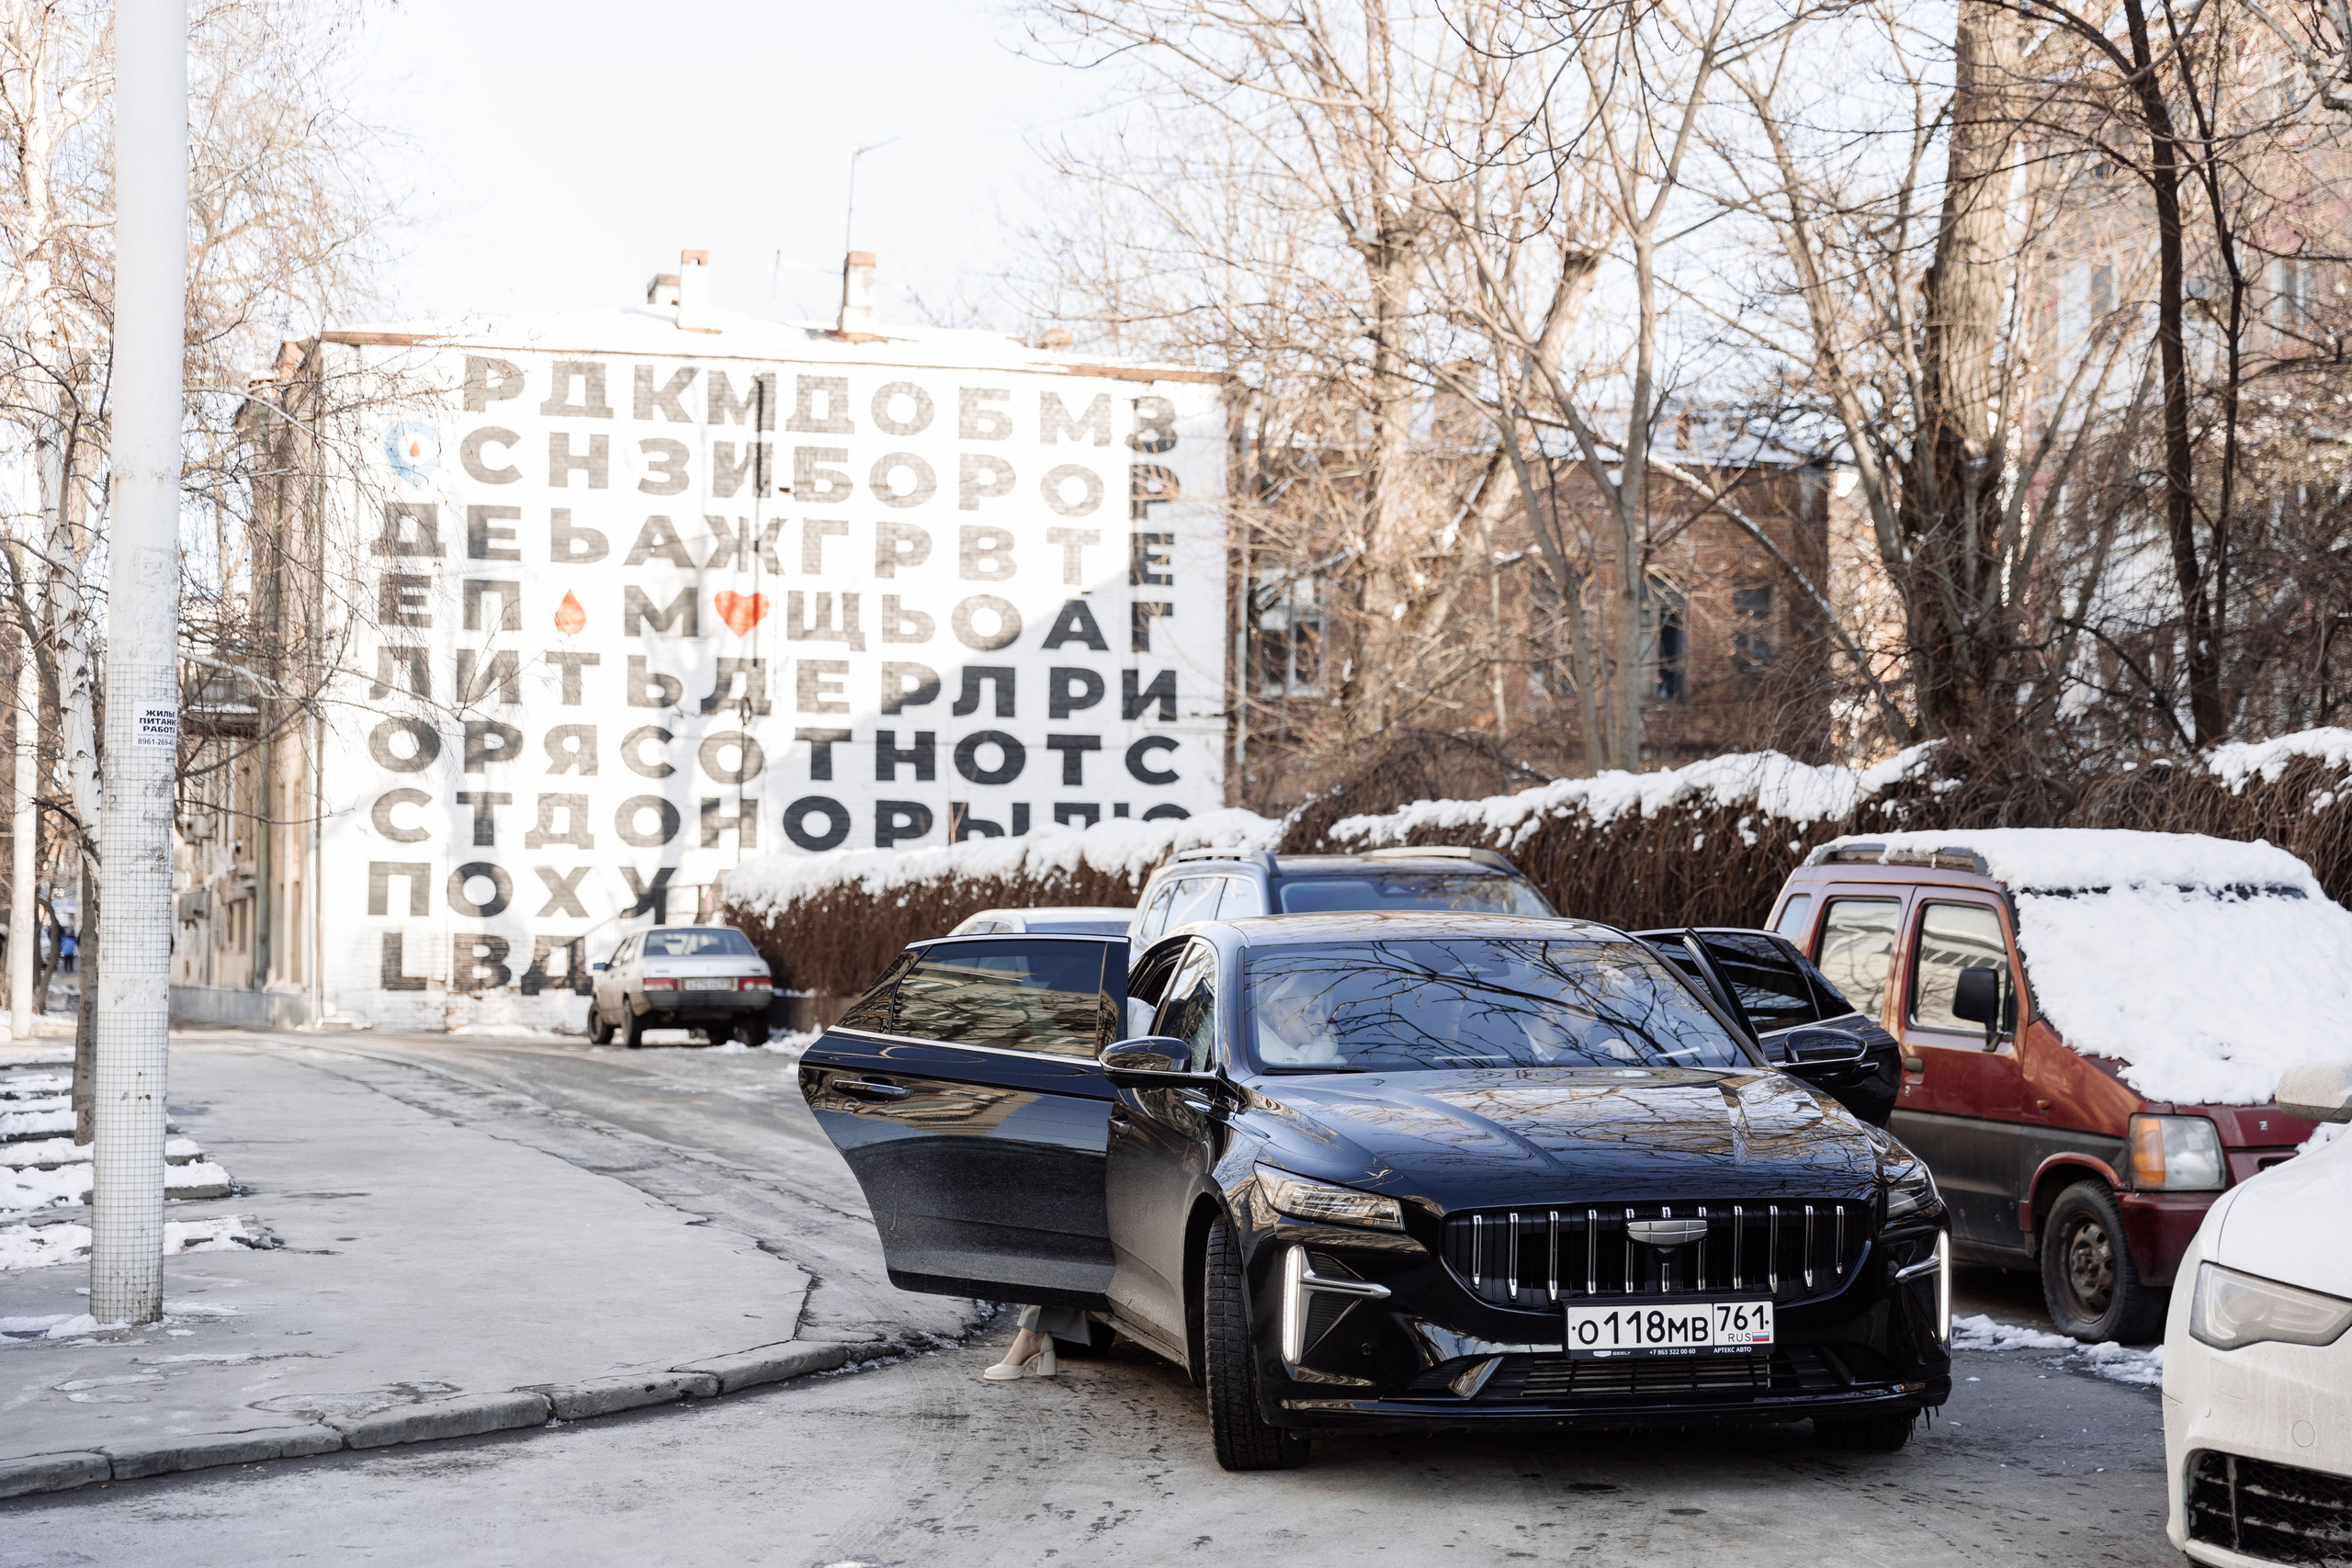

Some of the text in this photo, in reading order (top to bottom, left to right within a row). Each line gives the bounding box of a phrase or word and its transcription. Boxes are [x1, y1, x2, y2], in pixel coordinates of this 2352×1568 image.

[1578, 1305, 1764, 1345] О118МВ 761
[1727, 1333, 1751, 1342] RUS
